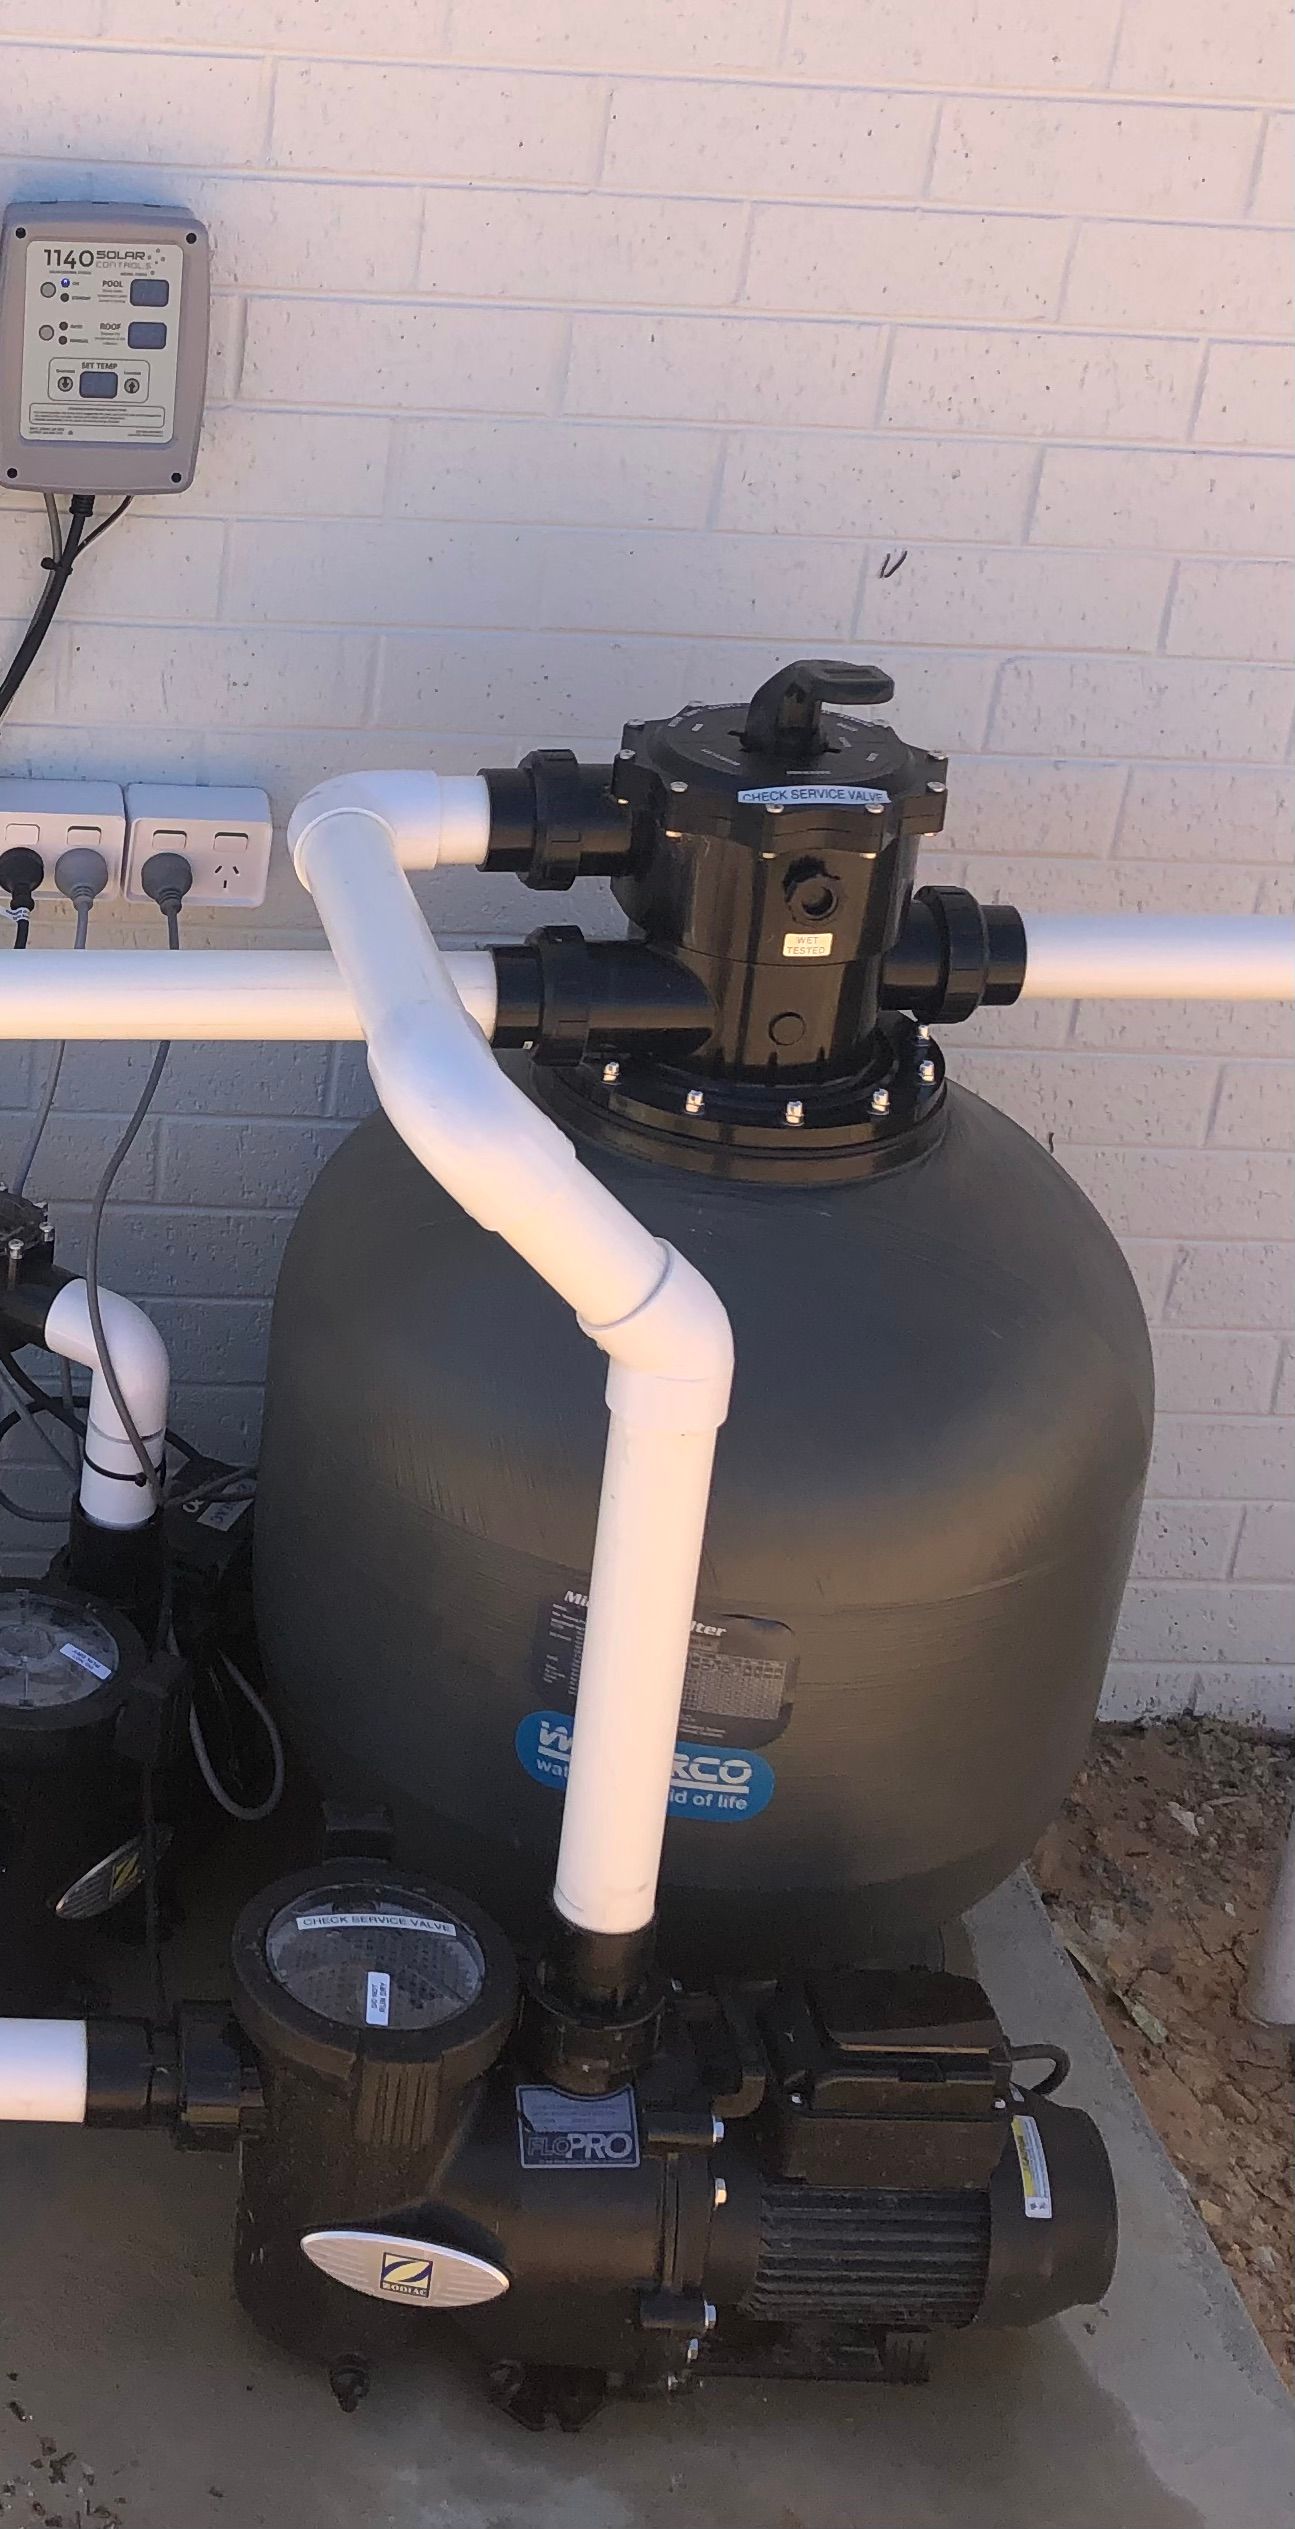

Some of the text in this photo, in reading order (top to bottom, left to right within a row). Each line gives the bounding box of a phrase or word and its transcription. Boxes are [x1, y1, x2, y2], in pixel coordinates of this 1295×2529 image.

[44, 249, 146, 269] 1140 SOLAR
[95, 261, 152, 270] CONTROLS
[102, 280, 124, 288] POOL
[99, 322, 122, 331] ROOF
[96, 362, 118, 370] TEMP
[742, 788, 883, 802] CHECK SERVICE VALVE
[796, 936, 820, 944] WET
[786, 946, 826, 955] TESTED
[692, 1793, 713, 1807] of
[718, 1794, 748, 1810] life
[302, 1915, 452, 1932] CHECK SERVICE VALVE
